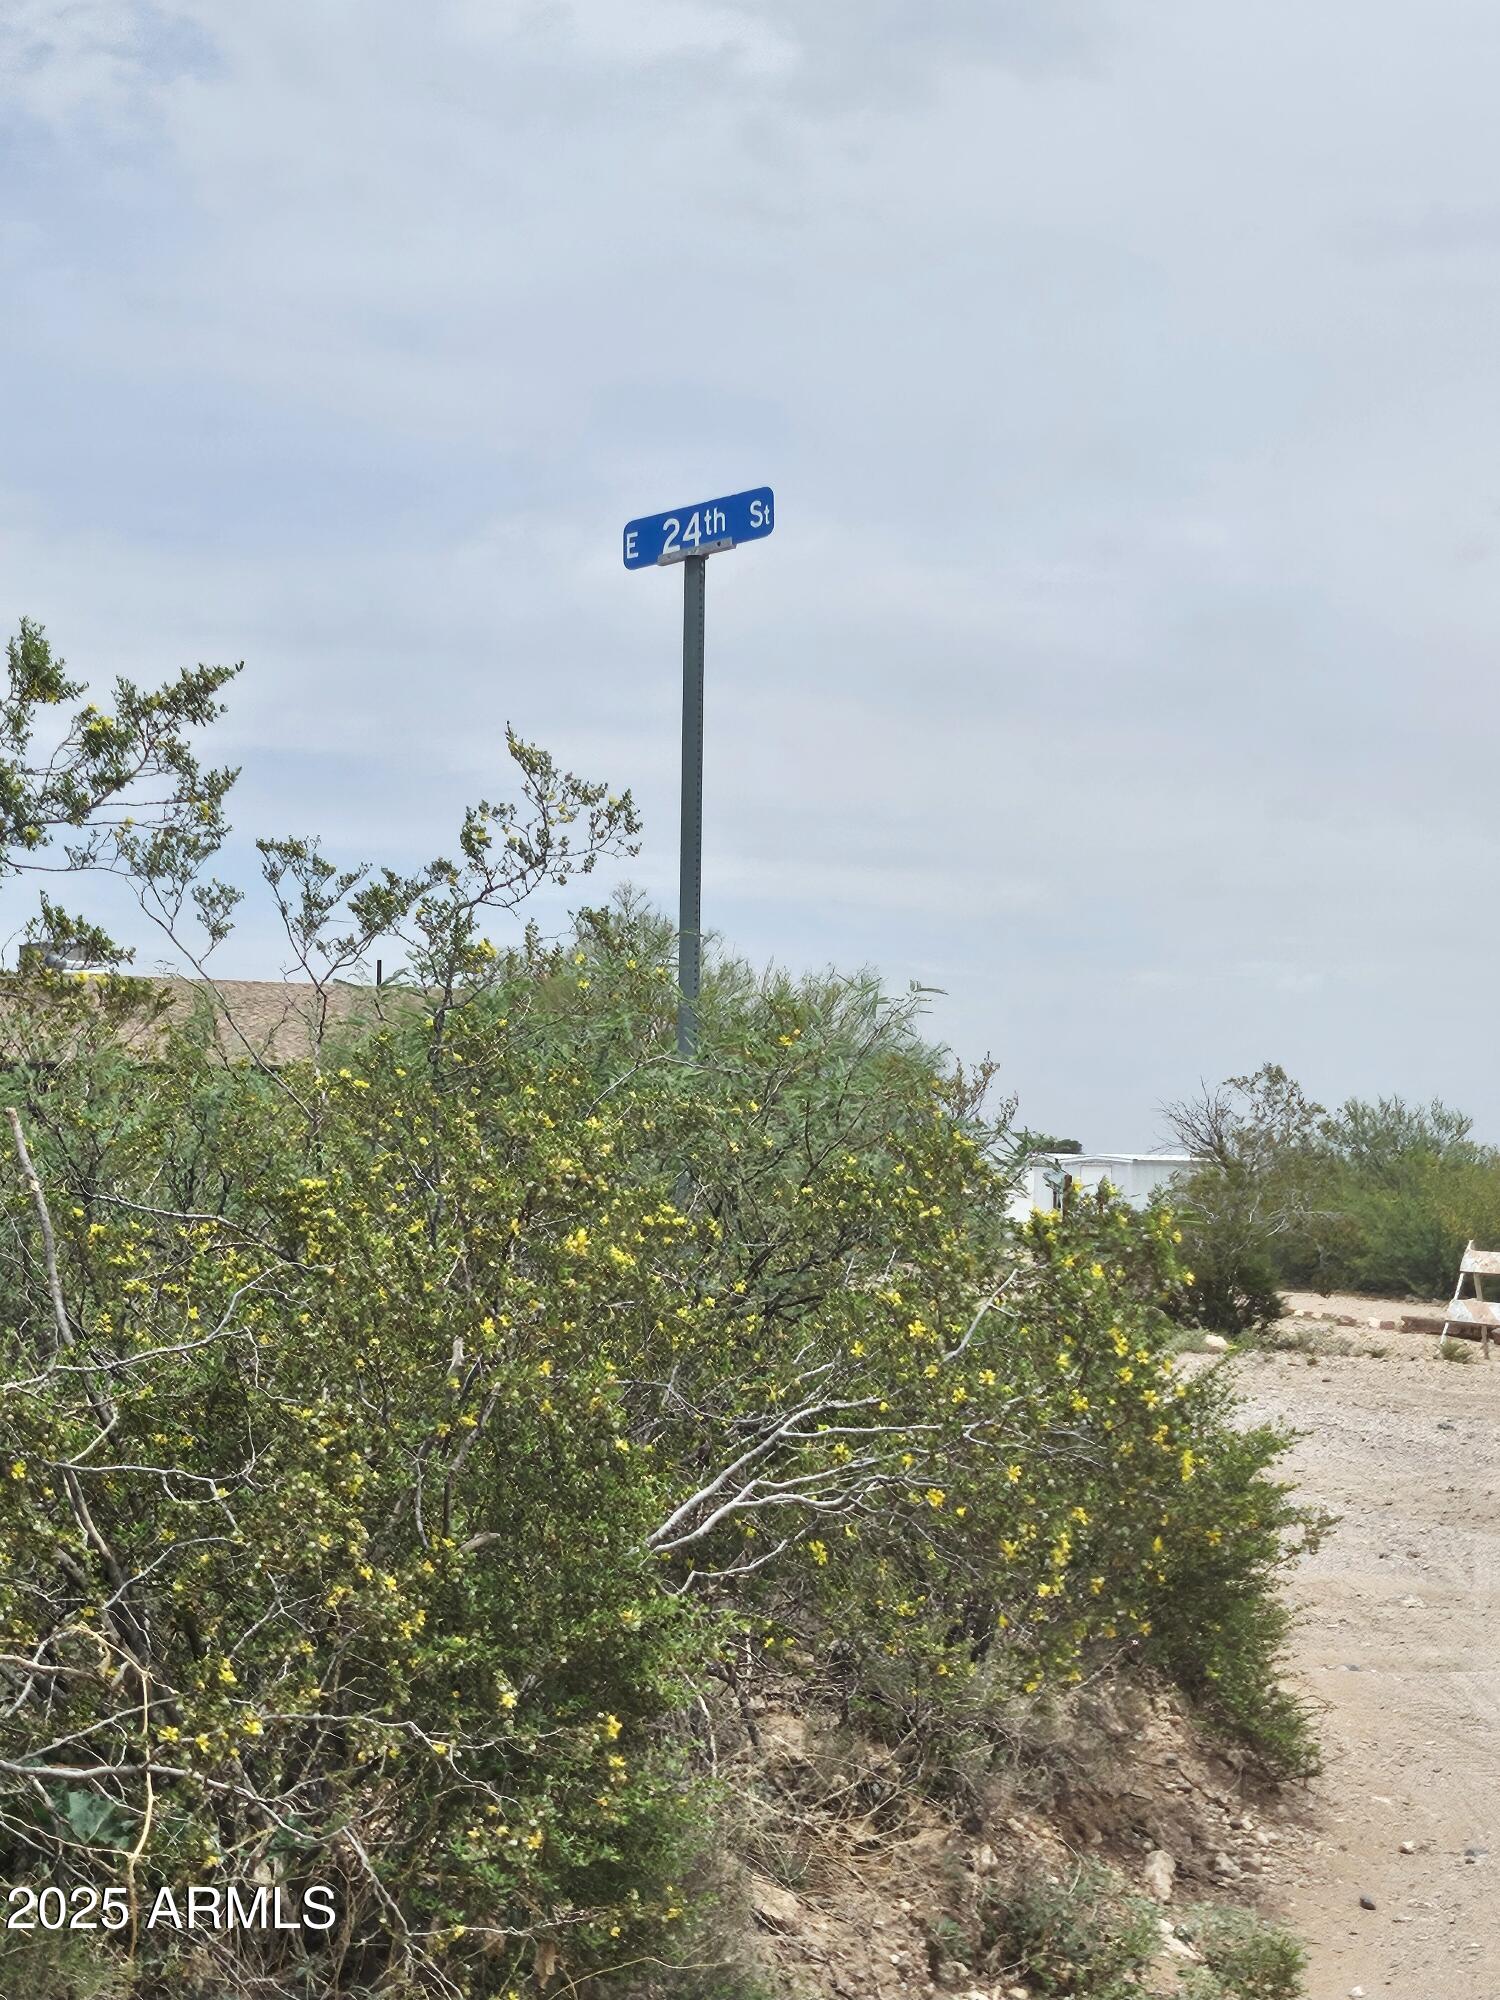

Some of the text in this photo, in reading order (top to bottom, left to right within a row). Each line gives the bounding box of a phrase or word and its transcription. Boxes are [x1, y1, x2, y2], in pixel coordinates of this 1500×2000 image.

[626, 500, 770, 559] E 24th St
